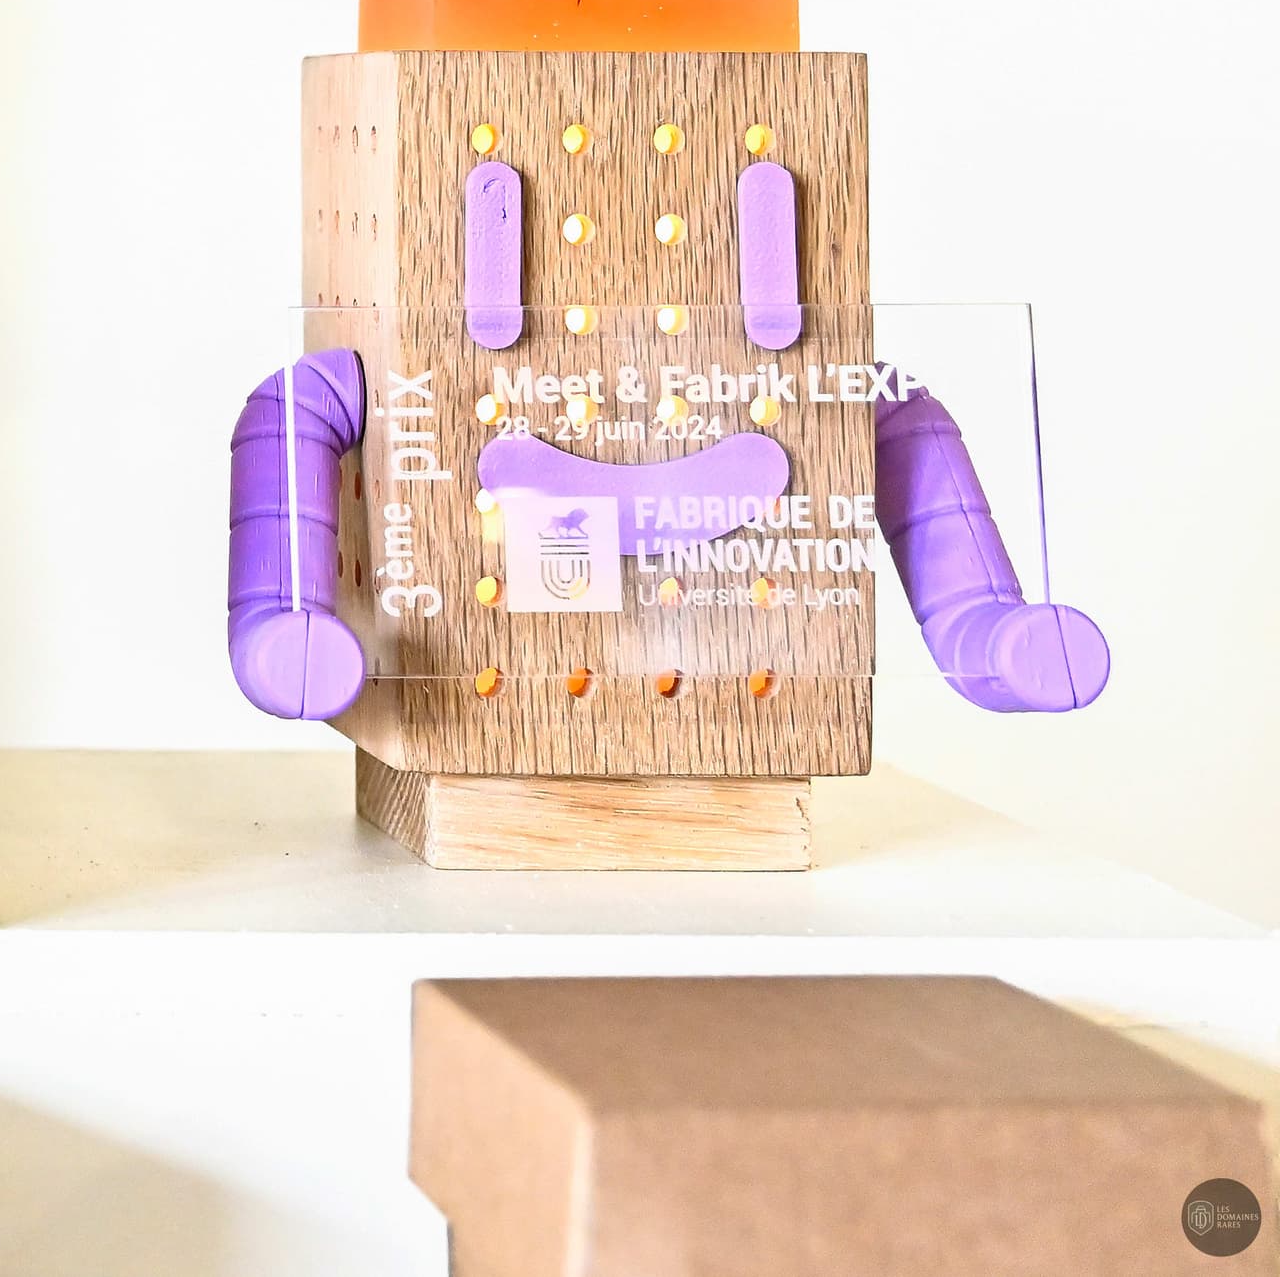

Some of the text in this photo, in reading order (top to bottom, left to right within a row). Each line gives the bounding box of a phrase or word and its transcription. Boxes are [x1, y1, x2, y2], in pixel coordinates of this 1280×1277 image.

[492, 363, 924, 405] Meet & Fabrik L'EXP
[496, 415, 530, 441] 28
[553, 415, 588, 441] 29
[594, 415, 646, 447] juin
[652, 414, 723, 441] 2024
[375, 369, 453, 619] 3ème prix
[634, 495, 874, 533] FABRIQUE DE
[636, 538, 876, 573] L'INNOVATION
[771, 582, 796, 606] de
[803, 583, 861, 610] Lyon
